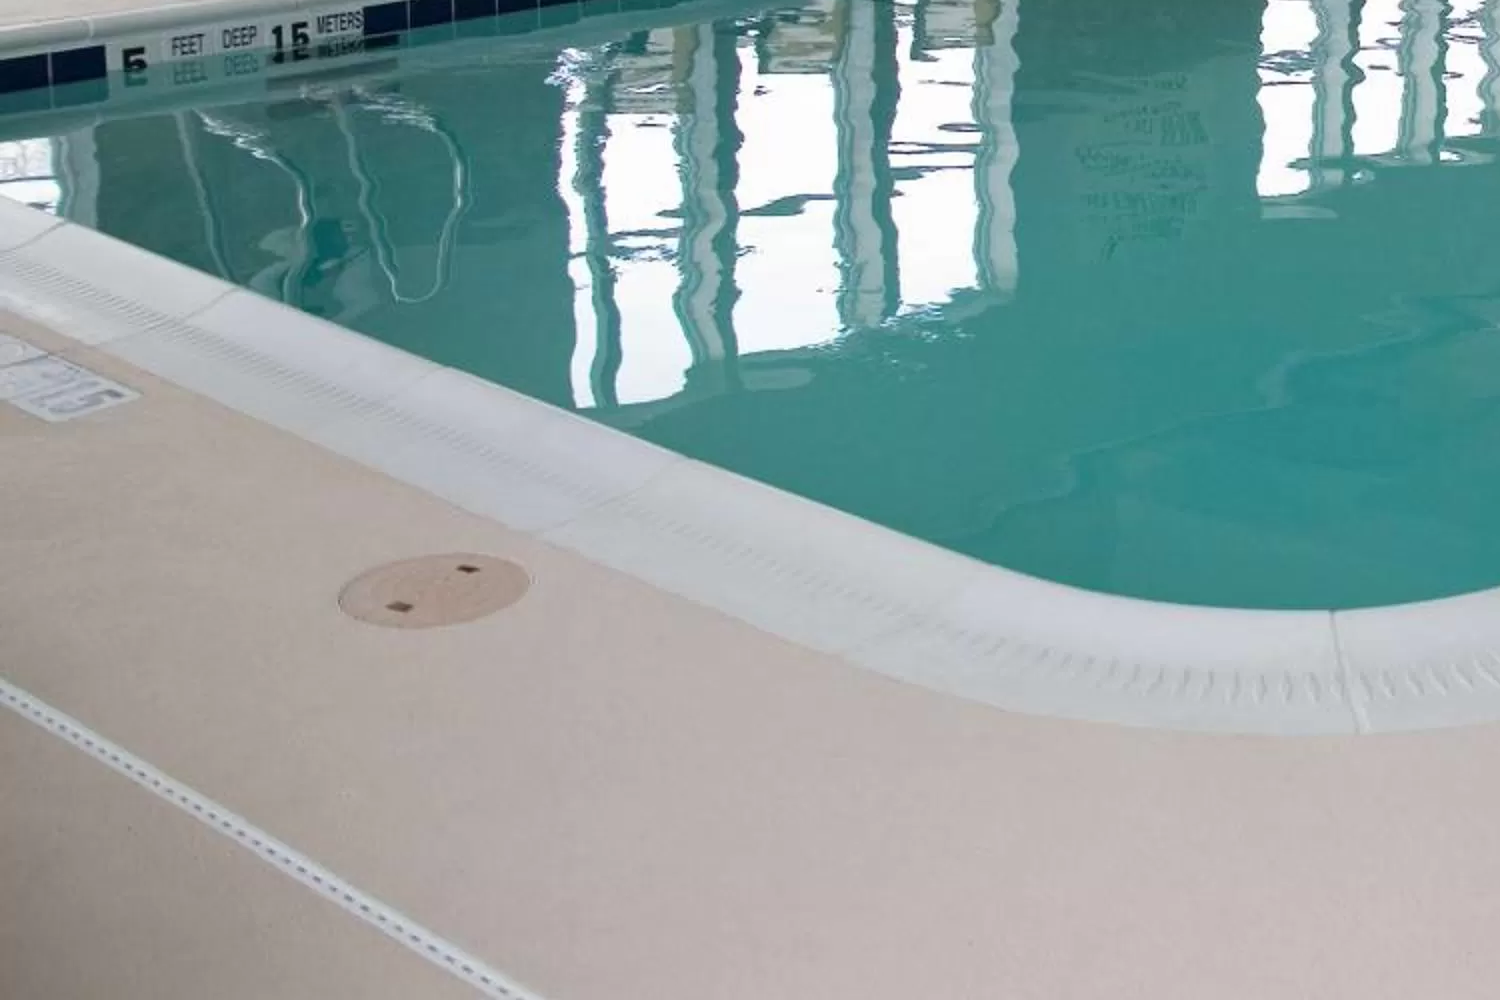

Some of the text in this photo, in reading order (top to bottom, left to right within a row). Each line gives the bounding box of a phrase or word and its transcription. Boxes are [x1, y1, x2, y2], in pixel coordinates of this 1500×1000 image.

[122, 46, 148, 74] 5
[171, 33, 206, 57] FEET
[222, 25, 257, 49] DEEP
[316, 10, 364, 34] METERS
